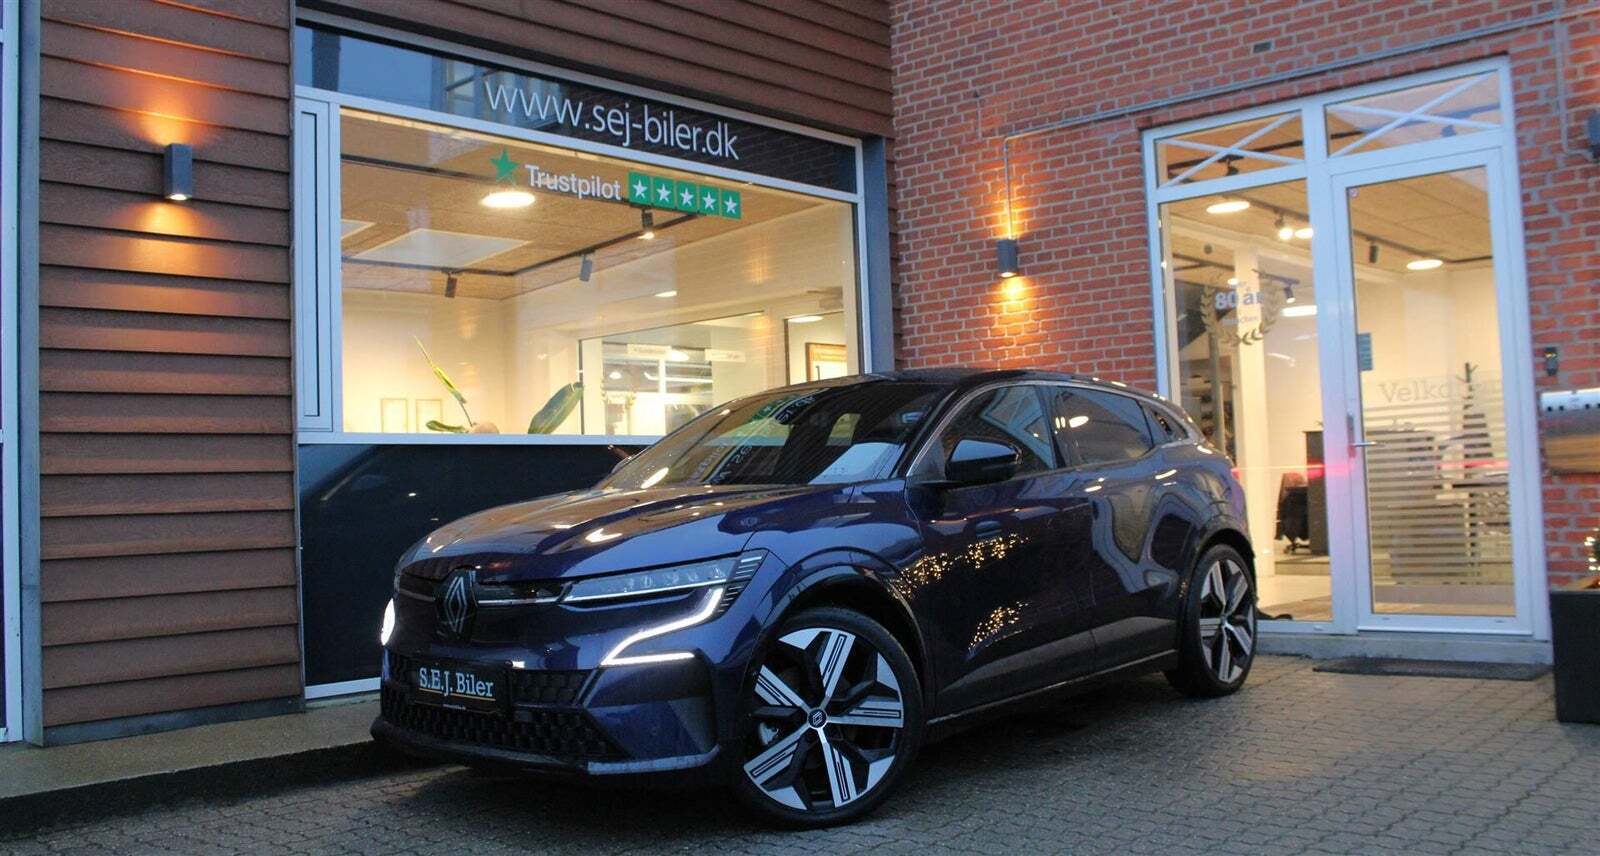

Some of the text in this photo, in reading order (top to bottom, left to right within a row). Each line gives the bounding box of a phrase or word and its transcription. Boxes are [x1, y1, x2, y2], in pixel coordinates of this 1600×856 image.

[485, 80, 739, 160] www.sej-biler.dk
[525, 164, 622, 201] Trustpilot
[1214, 290, 1238, 310] 80
[419, 667, 494, 697] S.E.J. Biler
